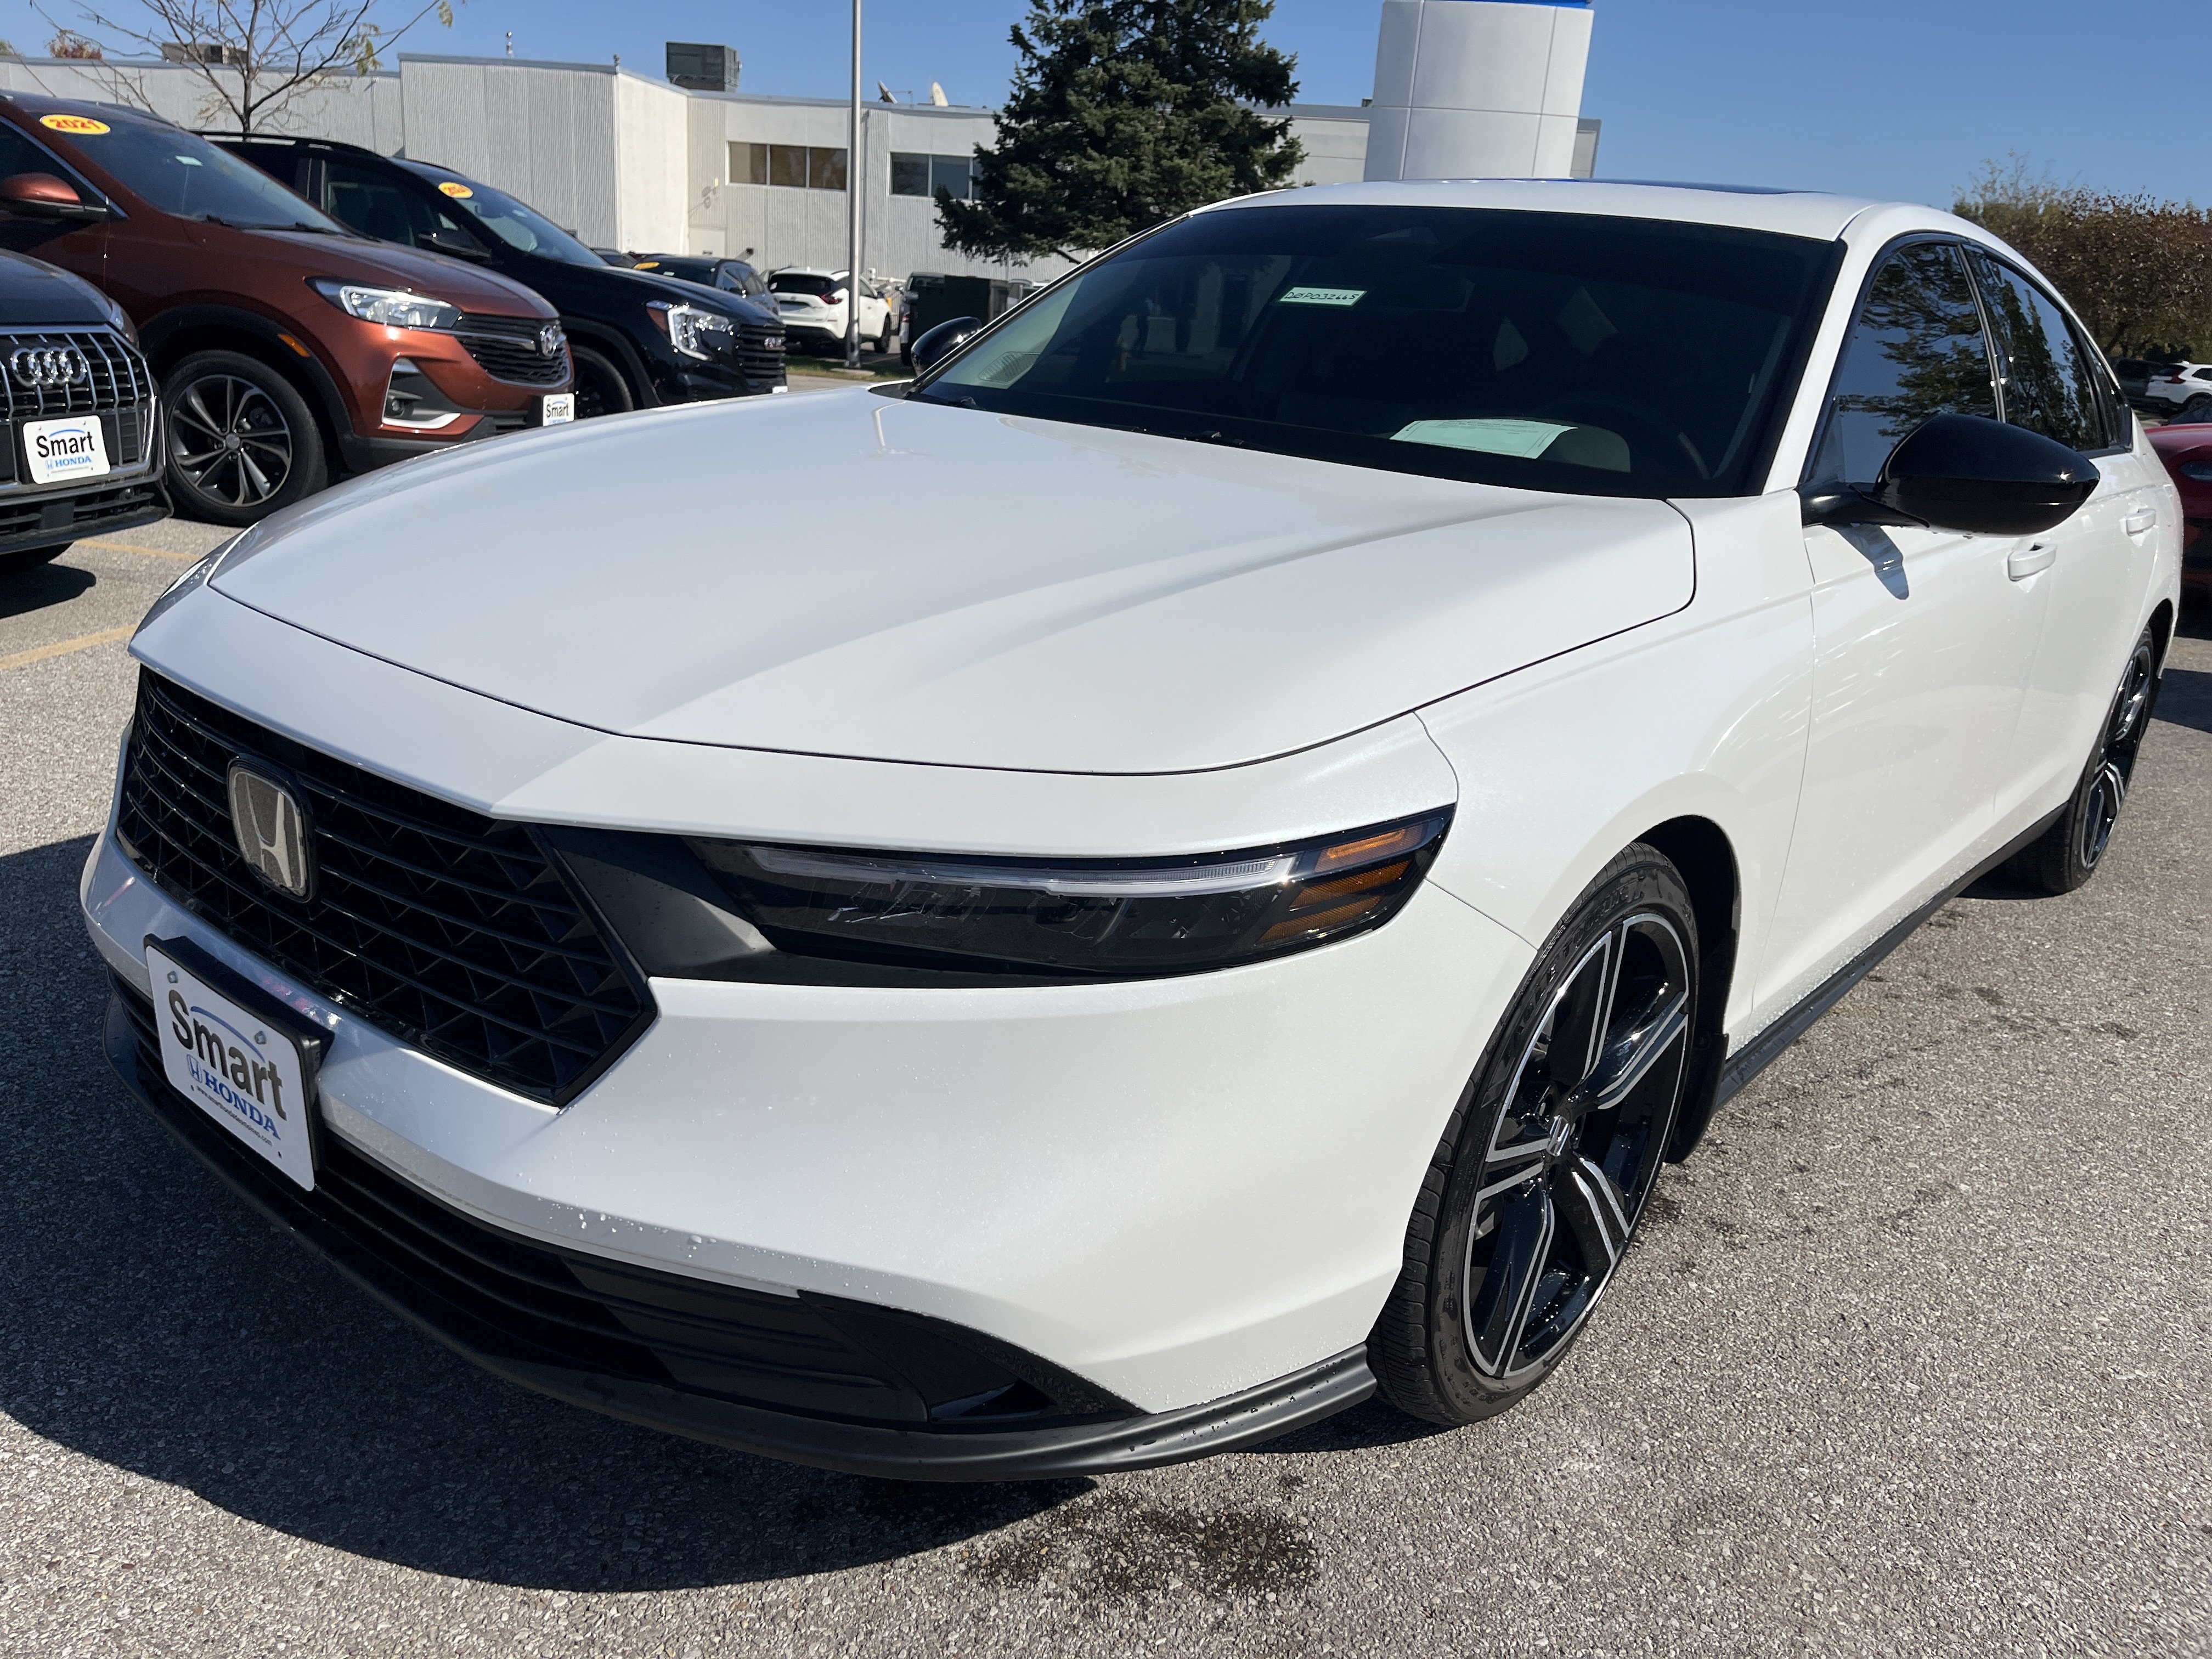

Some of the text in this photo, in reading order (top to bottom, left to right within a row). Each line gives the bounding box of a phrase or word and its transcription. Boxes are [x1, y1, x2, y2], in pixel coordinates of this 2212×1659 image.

[546, 402, 569, 418] Smart
[36, 431, 95, 458] Smart
[55, 455, 92, 467] HONDA
[168, 989, 287, 1121] Smart
[203, 1069, 281, 1141] HONDA
